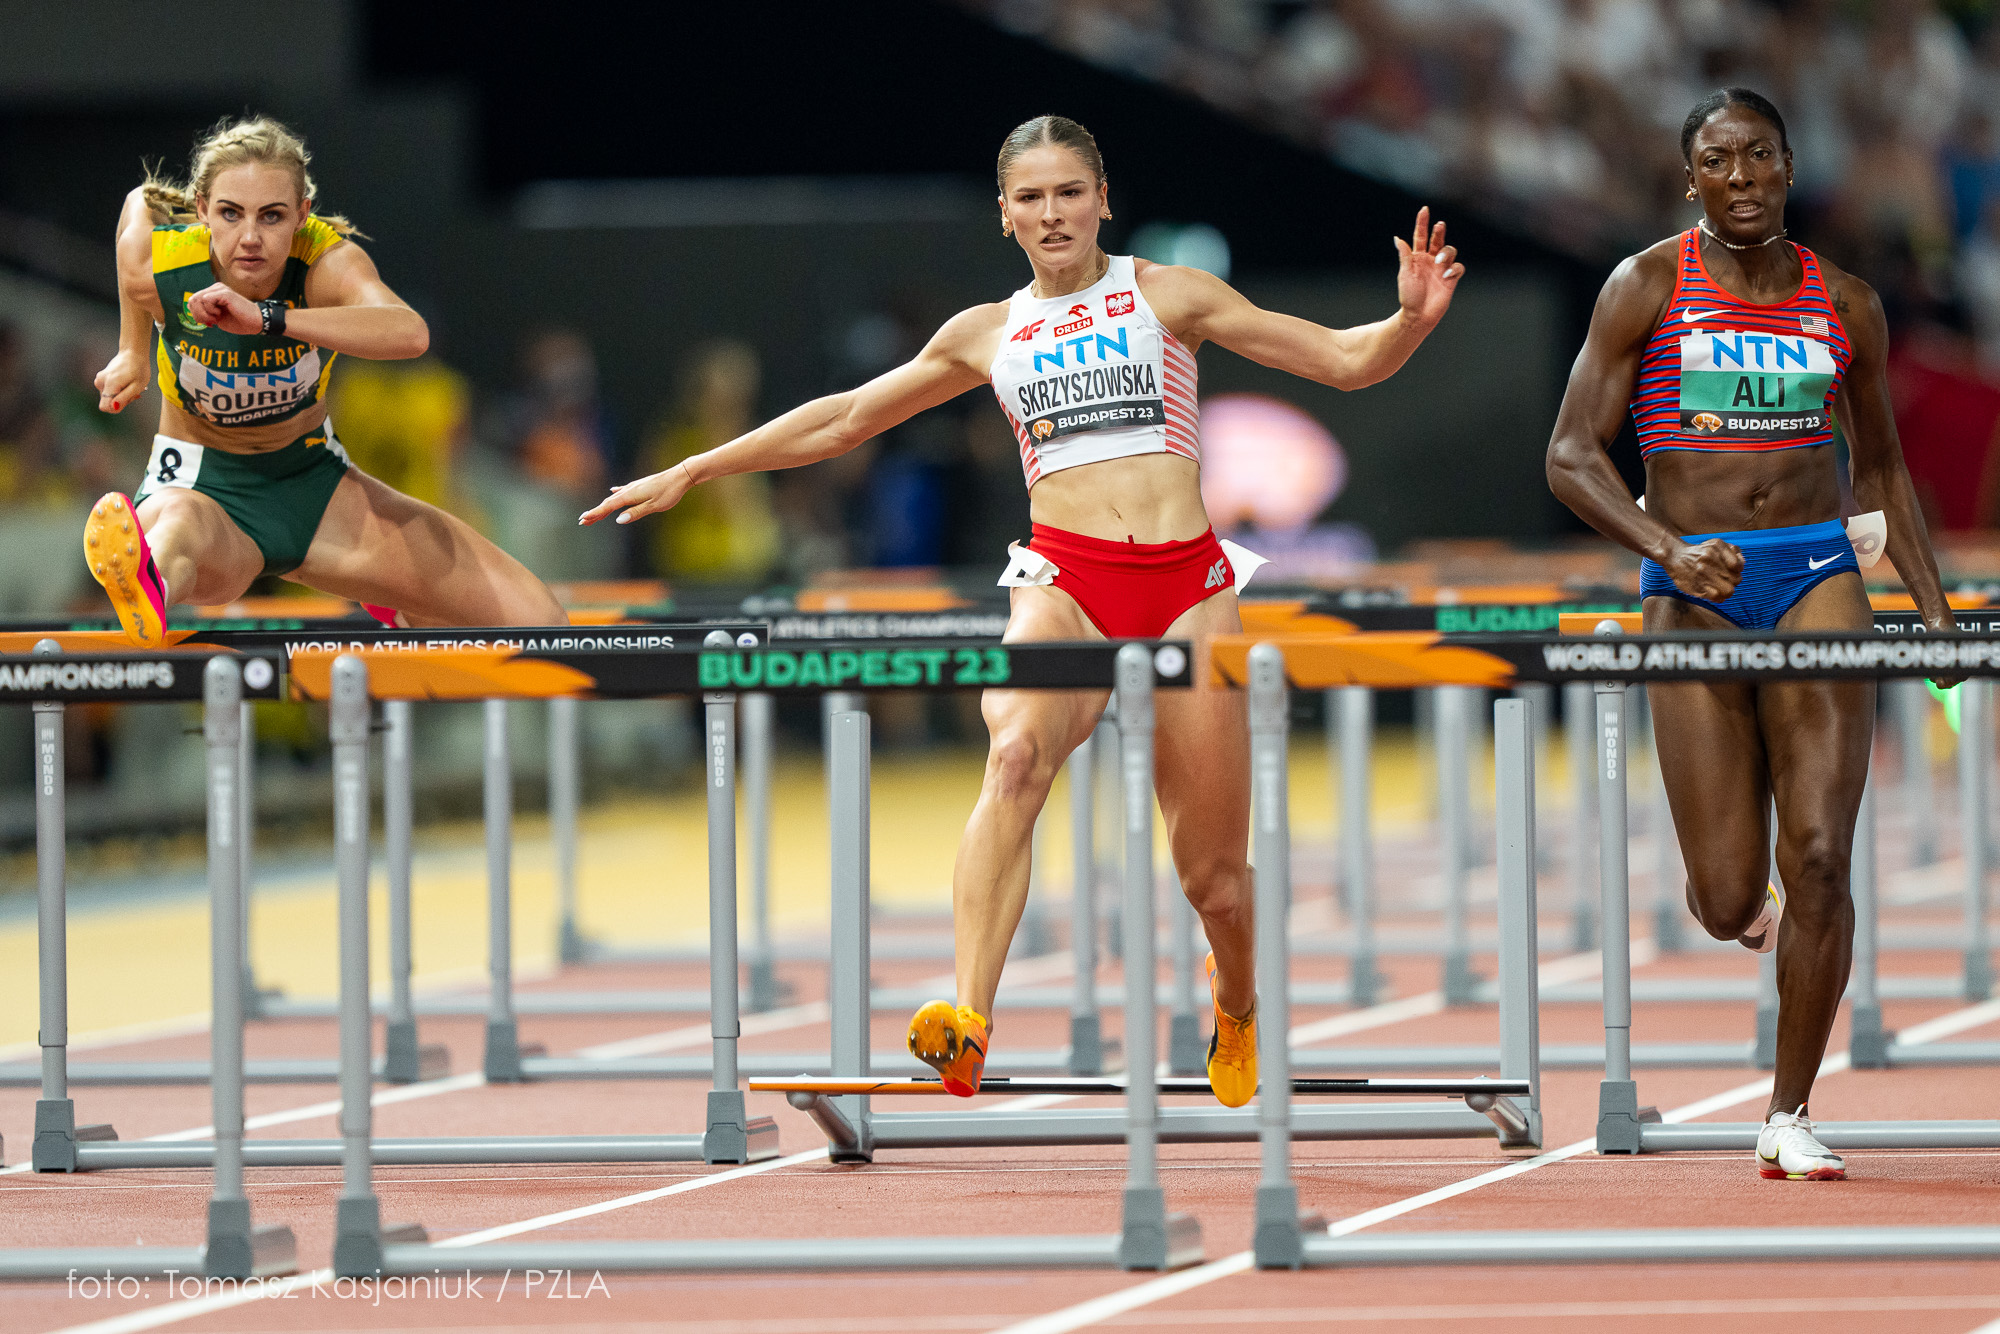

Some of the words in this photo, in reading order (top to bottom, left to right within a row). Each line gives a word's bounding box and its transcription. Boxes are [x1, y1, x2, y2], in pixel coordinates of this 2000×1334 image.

[1056, 318, 1092, 336] ORLEN
[178, 340, 239, 368] SOUTH
[1033, 327, 1130, 374] NTN
[1712, 335, 1808, 370] NTN
[205, 366, 297, 390] NTN
[1018, 363, 1157, 417] SKRZYSZOWSKA
[1731, 376, 1786, 408] ALI
[194, 380, 306, 411] FOURIE
[1057, 408, 1136, 429] BUDAPEST
[1138, 407, 1155, 418] 23
[1727, 418, 1804, 431] BUDAPEST
[1806, 416, 1820, 428] 23
[157, 447, 183, 483] 8
[700, 651, 947, 687] BUDAPEST
[955, 650, 1011, 685] 23
[1542, 643, 1642, 671] WORLD
[1643, 642, 1786, 670] ATHLETICS
[1788, 640, 2000, 669] CHAMPIONSHIPS
[41, 743, 55, 795] MONDO
[712, 735, 726, 787] MONDO
[1605, 727, 1618, 779] MONDO
